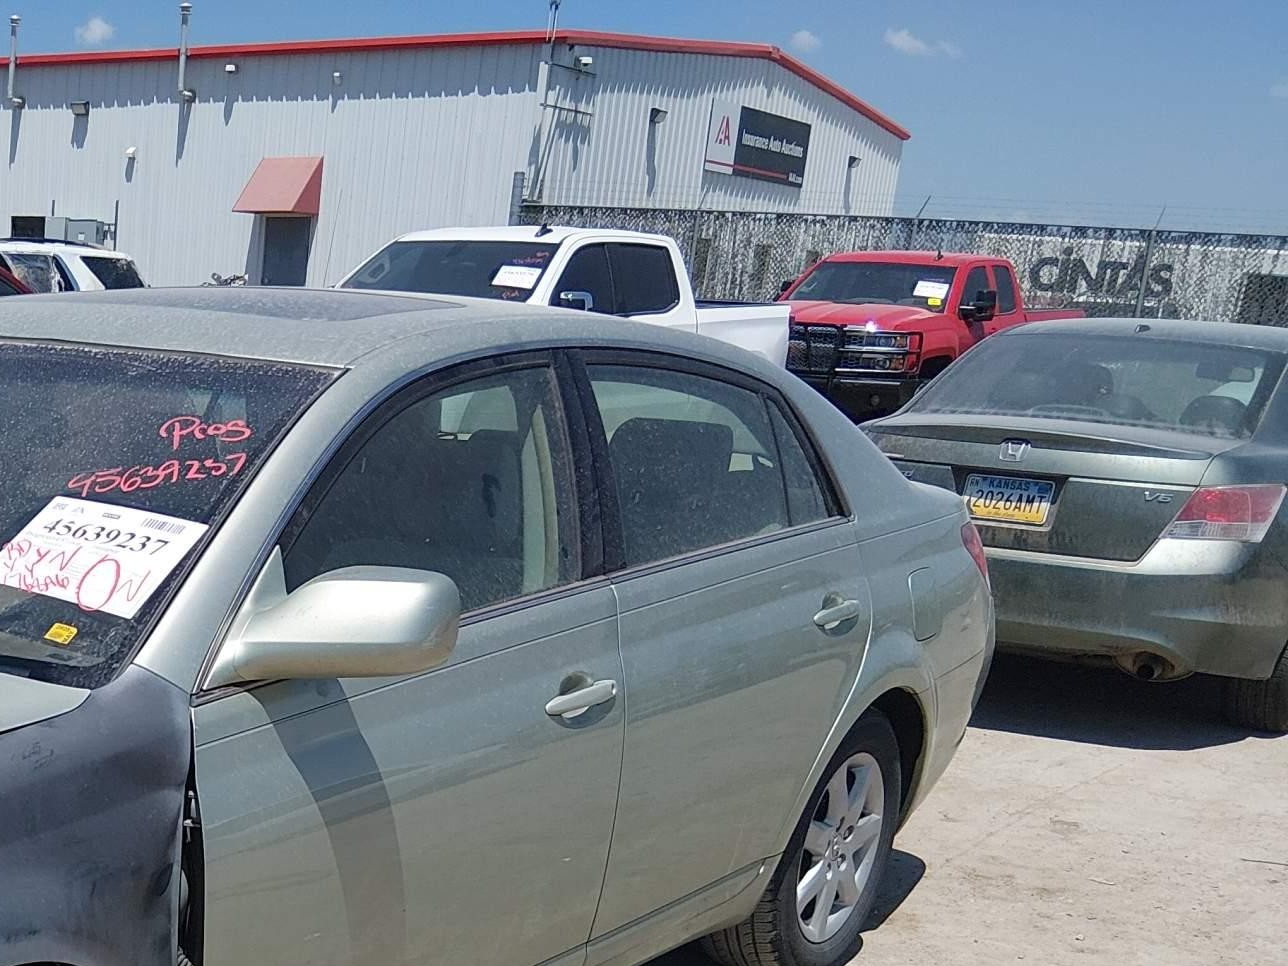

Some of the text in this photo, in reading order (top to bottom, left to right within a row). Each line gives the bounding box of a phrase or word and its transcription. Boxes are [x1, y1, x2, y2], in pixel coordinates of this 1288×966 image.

[742, 129, 804, 158] Insurance Auto Auctions
[988, 479, 1031, 492] KANSAS
[972, 489, 1047, 514] 2026AMT
[43, 518, 171, 555] 45639237
